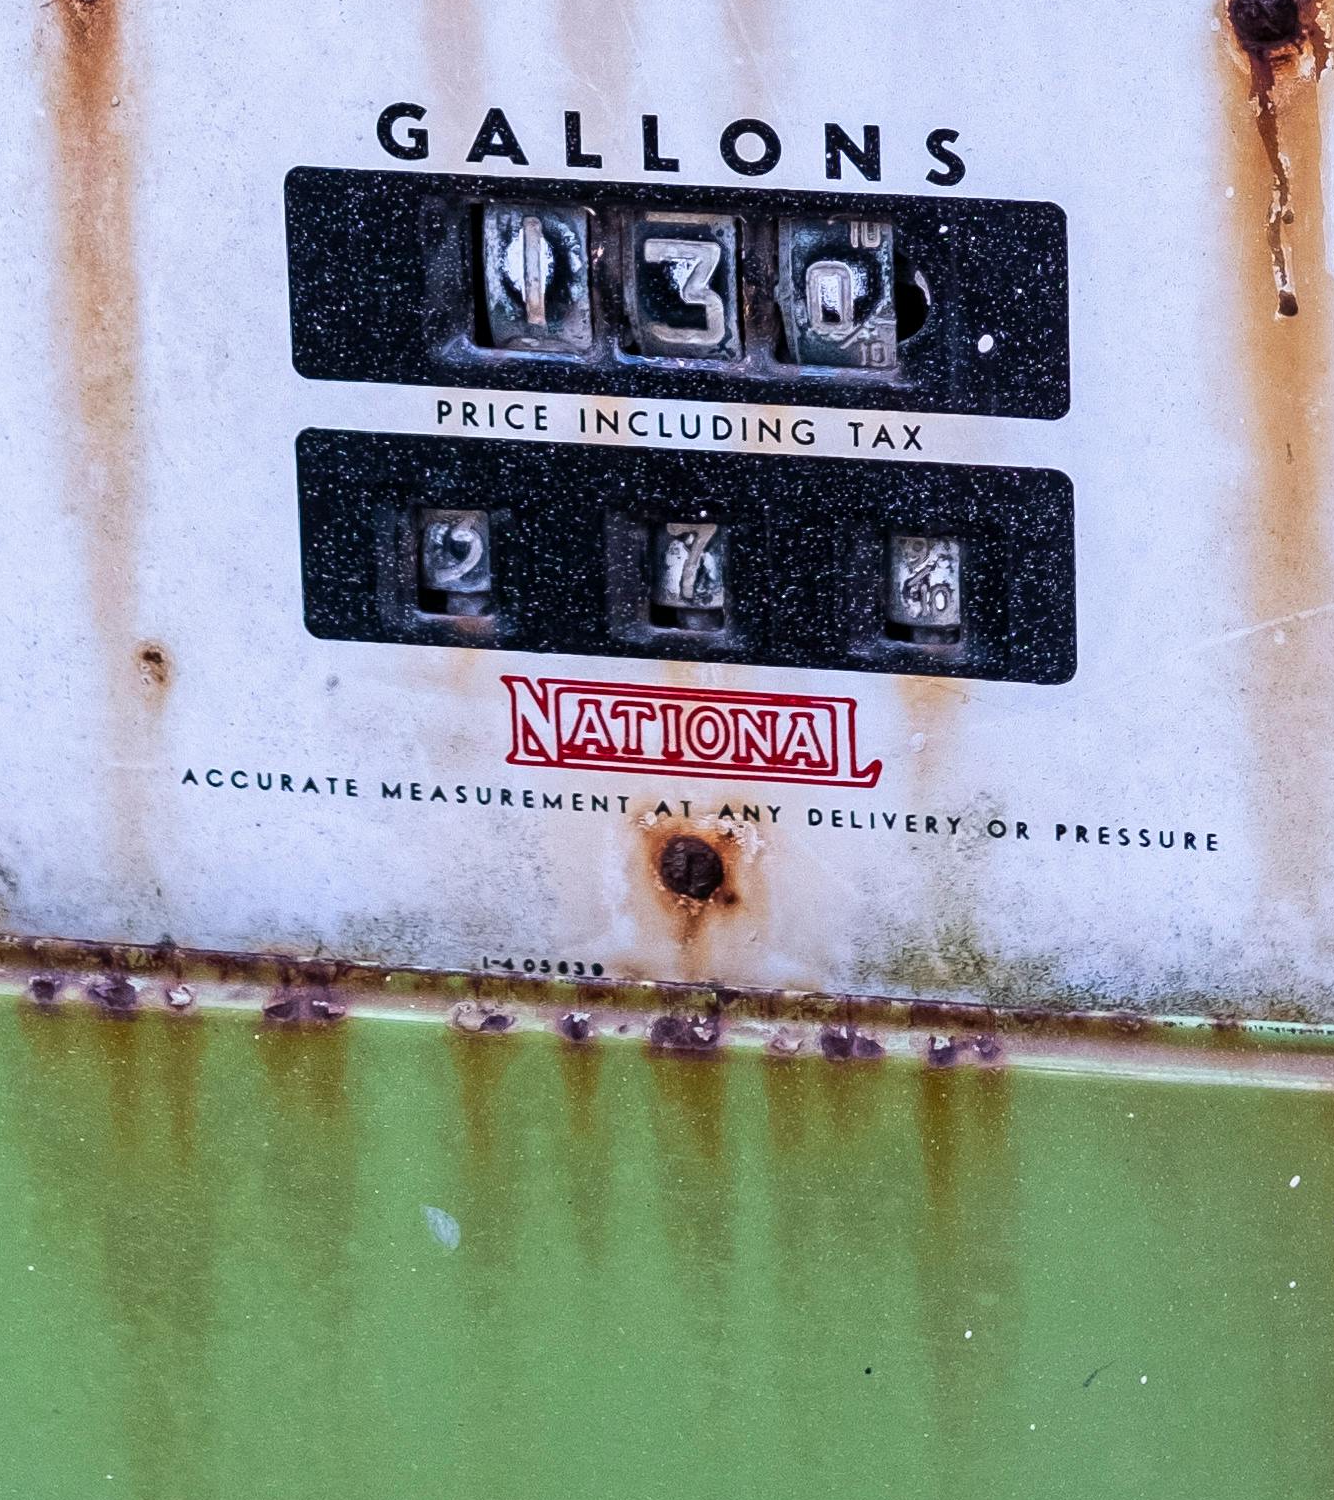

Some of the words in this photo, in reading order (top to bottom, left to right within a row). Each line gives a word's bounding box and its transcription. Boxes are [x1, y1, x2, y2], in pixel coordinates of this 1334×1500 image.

[377, 103, 965, 186] GALLONS
[438, 400, 547, 430] PRICE
[581, 408, 815, 445] INCLUDING
[848, 421, 922, 450] TAX
[501, 675, 883, 788] NATIONAL
[182, 769, 358, 796] ACCURATE
[381, 782, 629, 814] MEASUREMENT
[654, 800, 690, 818] AT
[719, 803, 781, 823] ANY
[807, 808, 962, 835] DELIVERY
[987, 820, 1029, 839] OR
[1055, 823, 1218, 852] PRESSURE
